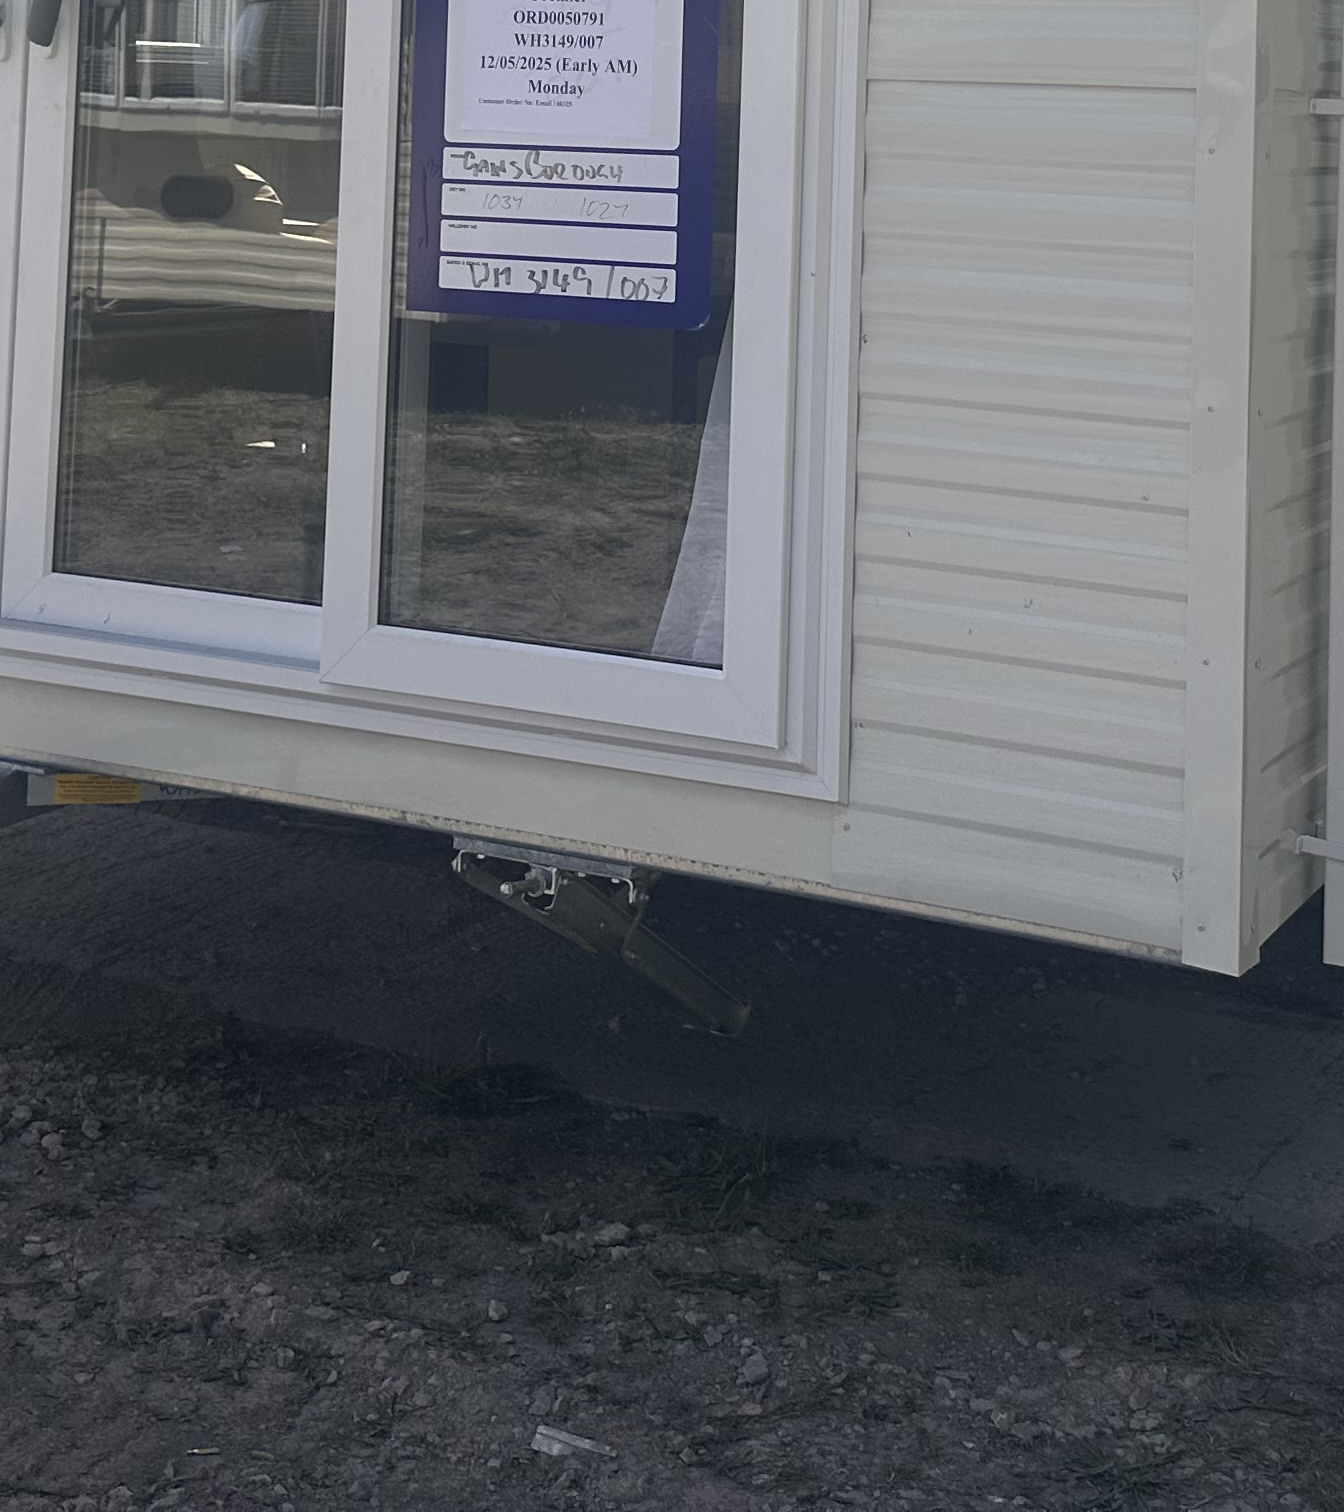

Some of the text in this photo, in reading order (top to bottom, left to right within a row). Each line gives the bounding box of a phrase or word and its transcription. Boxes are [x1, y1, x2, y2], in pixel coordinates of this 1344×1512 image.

[513, 9, 605, 26] ORD0050791
[514, 32, 604, 49] WH3149/007
[480, 54, 639, 77] 12/05/2025 (Early AM)
[528, 79, 585, 99] Monday
